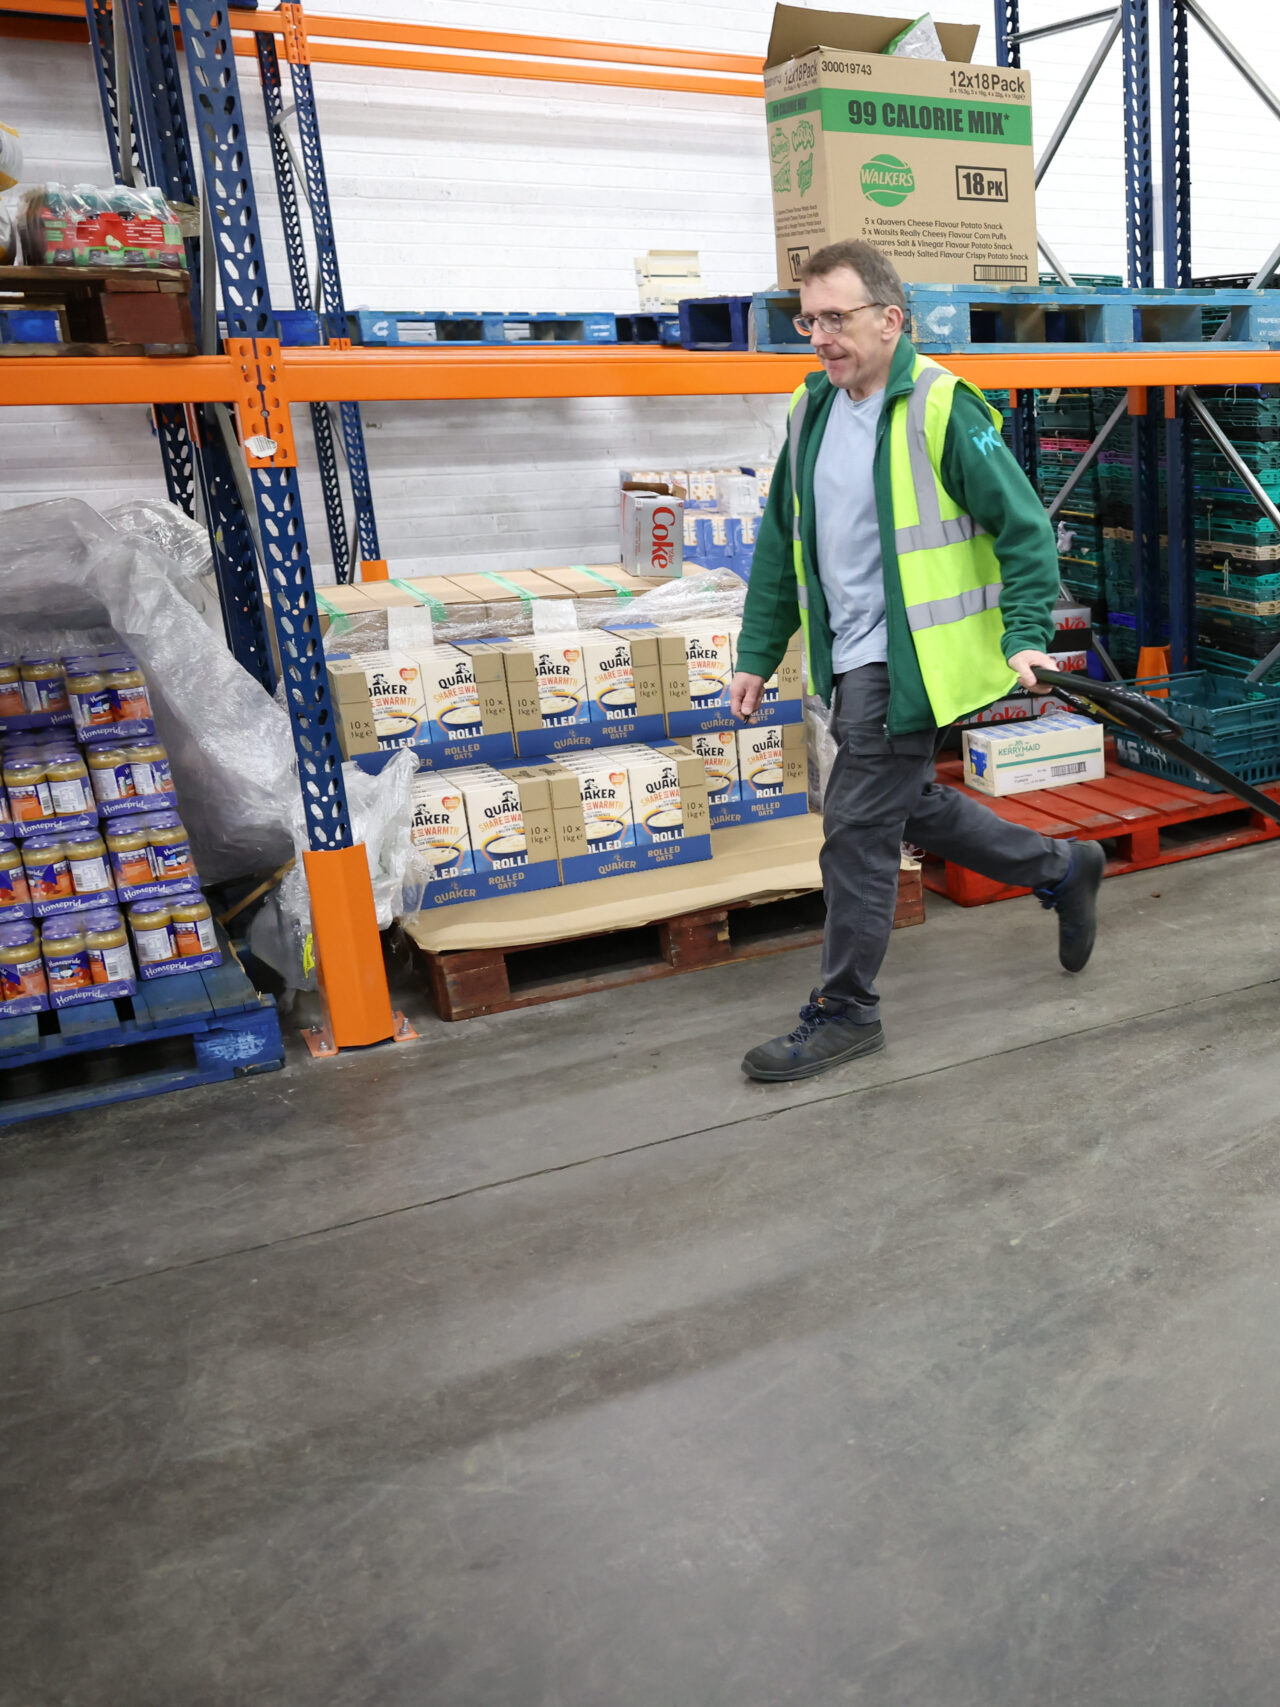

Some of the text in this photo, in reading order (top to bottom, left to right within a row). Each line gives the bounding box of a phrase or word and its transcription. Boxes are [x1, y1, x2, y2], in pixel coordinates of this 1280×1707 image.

[822, 60, 872, 76] 300019743
[848, 100, 877, 126] 99
[882, 102, 964, 132] CALORIE
[860, 168, 913, 186] WALKERS
[962, 172, 1004, 196] 18 PK
[876, 218, 906, 226] Quavers
[907, 219, 934, 227] Cheese
[935, 220, 959, 229] Flavour
[900, 229, 920, 237] Really
[922, 230, 946, 239] Cheesy
[948, 231, 972, 239] Flavour
[918, 239, 944, 249] Vinegar
[945, 241, 970, 249] Flavour
[894, 250, 916, 258] Ready
[966, 252, 986, 260] Crispy
[652, 506, 676, 568] Coke
[1054, 617, 1086, 630] oke
[686, 650, 718, 660] AKER
[600, 658, 631, 672] QUAK
[1050, 656, 1085, 672] oke
[535, 666, 570, 676] AKER
[438, 674, 476, 689] QUAK
[368, 685, 407, 697] UAKER
[434, 688, 458, 703] SHARE
[382, 697, 417, 706] WARMTH
[485, 698, 495, 707] 10
[518, 699, 527, 707] 10
[691, 698, 721, 710] LLED
[606, 708, 638, 720] ROLL
[350, 721, 360, 730] 10
[542, 716, 576, 728] LLED
[700, 719, 735, 730] QUAKER
[351, 730, 364, 738] 1kg
[448, 726, 484, 740] ROLL
[602, 724, 635, 735] ROLLED
[554, 737, 592, 749] QUAKER
[752, 740, 783, 753] QUAK
[444, 744, 480, 756] ROLLED
[693, 747, 724, 757] AKER
[998, 743, 1040, 756] KERRYMAID
[646, 778, 680, 793] QUAK
[580, 789, 616, 801] AKER
[756, 787, 784, 799] ROLL
[484, 802, 522, 819] QUAK
[751, 802, 780, 812] ROLLED
[412, 815, 450, 828] AKER
[478, 818, 503, 833] SHARE
[424, 826, 459, 837] WARMTH
[530, 827, 540, 835] 10
[563, 825, 573, 833] 10
[652, 829, 684, 843] ROLL
[587, 840, 622, 854] LLED
[648, 846, 680, 858] ROLLED
[492, 855, 529, 870] ROLL
[598, 860, 637, 874] QUAKER
[488, 872, 525, 885] ROLLED
[498, 881, 518, 890] OATS
[434, 888, 476, 904] QUAKER
